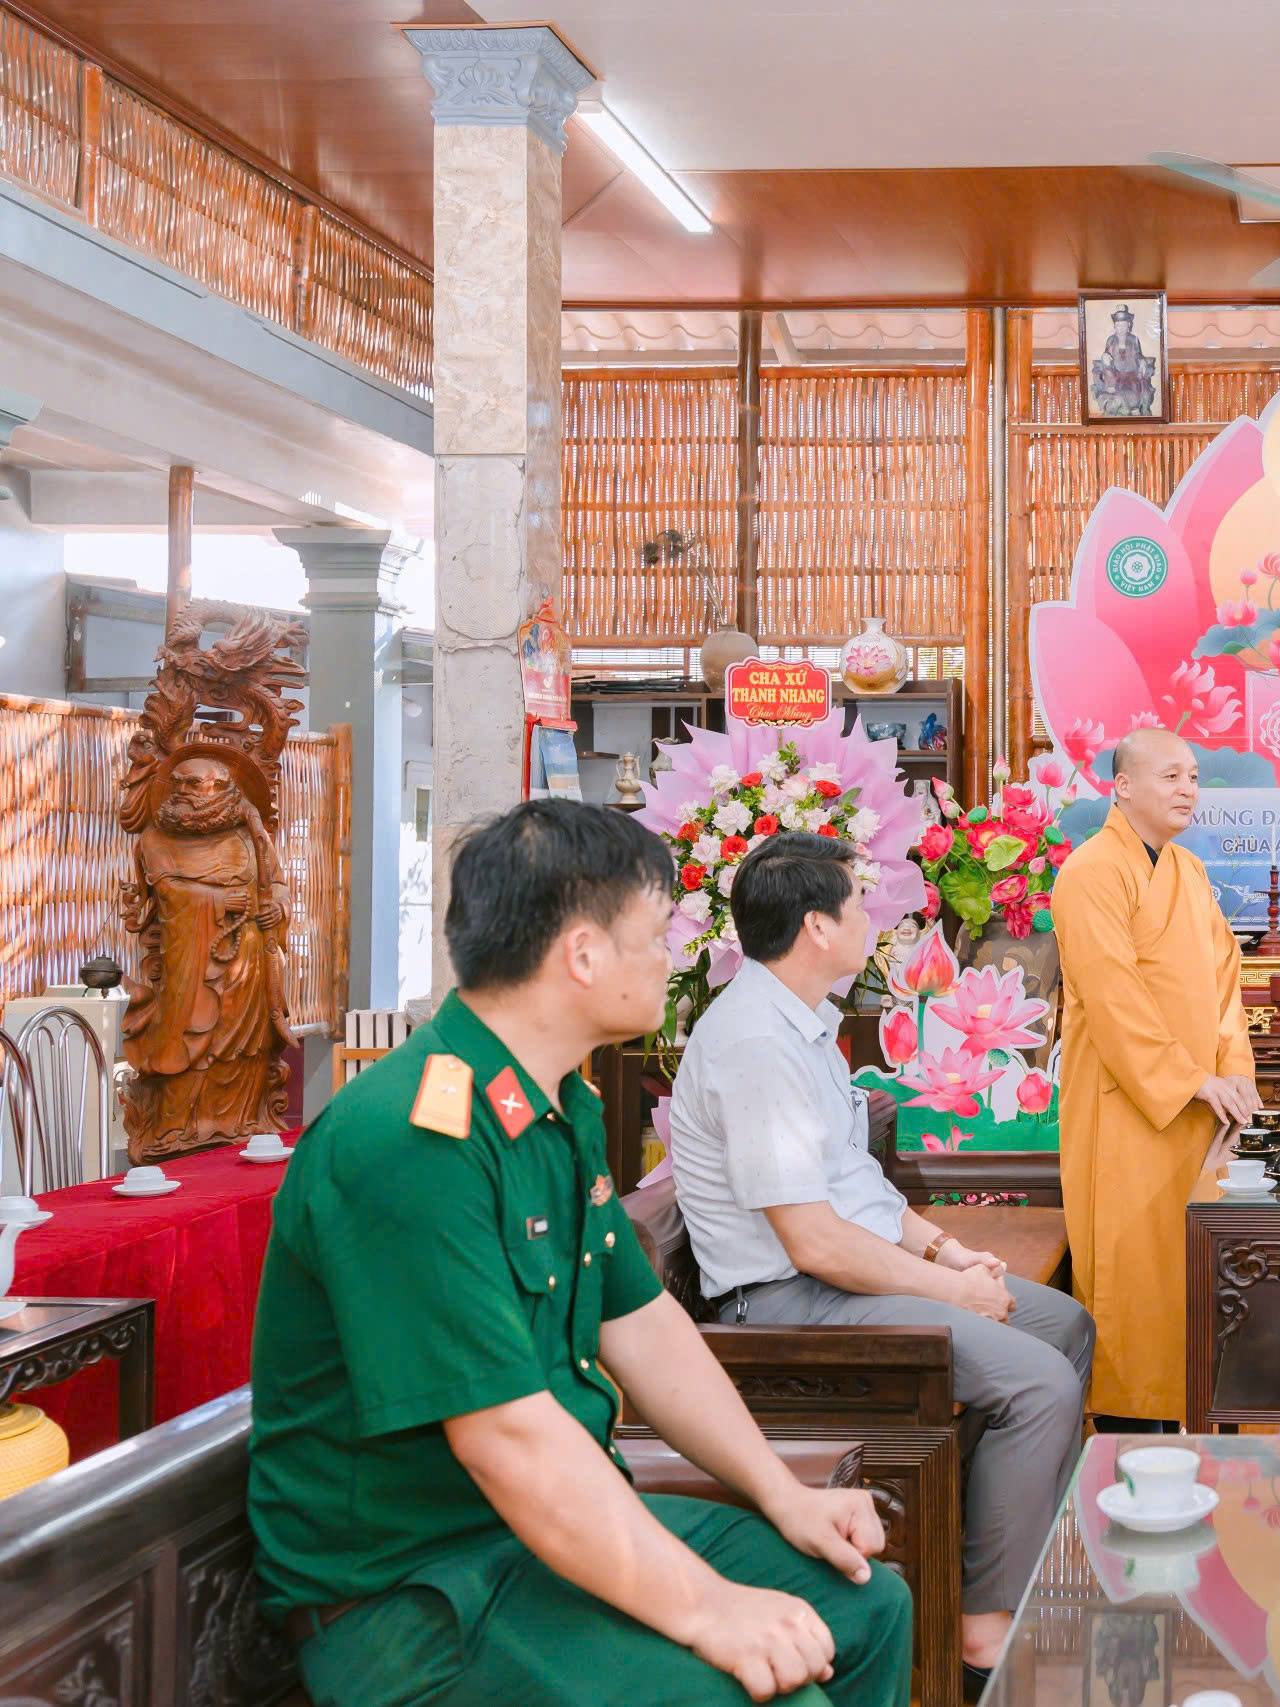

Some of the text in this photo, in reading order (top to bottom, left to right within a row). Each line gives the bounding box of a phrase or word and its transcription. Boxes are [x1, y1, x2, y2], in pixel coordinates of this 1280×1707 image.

[748, 668, 808, 686] CHA XỨ
[731, 687, 826, 704] THANH NHANG
